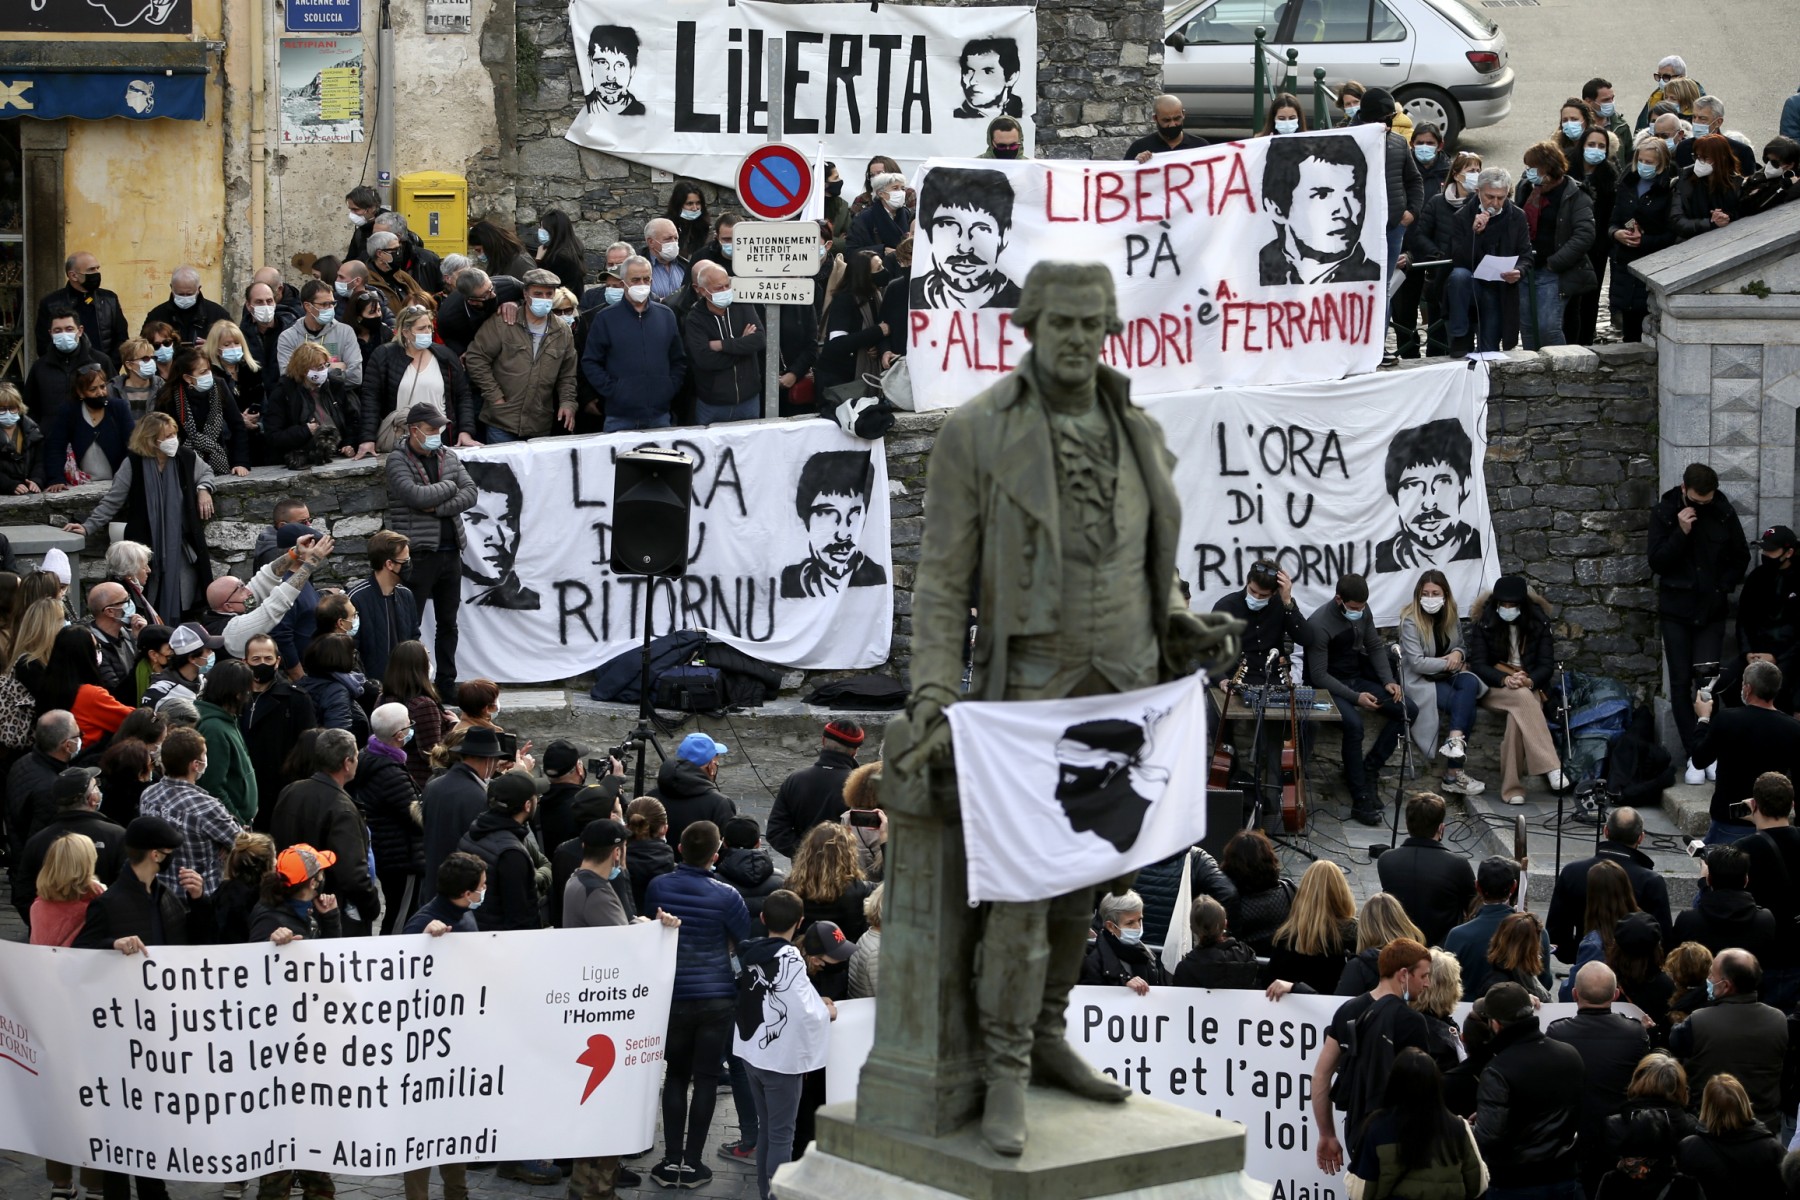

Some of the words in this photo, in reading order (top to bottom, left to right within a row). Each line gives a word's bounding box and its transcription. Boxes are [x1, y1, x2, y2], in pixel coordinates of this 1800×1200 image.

[304, 13, 343, 22] SCOLICCIA
[426, 15, 471, 26] POTERIE
[736, 236, 817, 245] STATIONNEMENT
[746, 254, 774, 262] PETIT
[779, 253, 808, 261] TRAIN
[738, 291, 805, 301] LIVRAISONS
[758, 281, 787, 290] SAUF
[1216, 421, 1350, 479] L'ORA
[1286, 491, 1314, 528] U
[142, 957, 249, 991] Contre
[264, 950, 434, 986] l'arbitraire
[582, 965, 620, 984] Ligue
[545, 989, 571, 1004] des
[578, 986, 627, 1003] droits
[632, 983, 649, 999] de
[92, 997, 125, 1029] et
[135, 998, 156, 1032] la
[169, 999, 278, 1042] justice
[292, 988, 465, 1032] d'exception
[563, 1008, 636, 1024] l'Homme
[1083, 1004, 1170, 1043] Pour
[1188, 1005, 1219, 1045] le
[129, 1038, 193, 1074] Pour
[208, 1041, 233, 1074] la
[249, 1032, 327, 1071] levée
[342, 1034, 393, 1067] des
[406, 1026, 452, 1063] DPS
[625, 1035, 661, 1051] Section
[624, 1054, 637, 1067] de
[640, 1049, 664, 1064] Corse
[1169, 1056, 1208, 1096] et
[79, 1076, 111, 1107] et
[121, 1077, 142, 1111] le
[154, 1075, 388, 1125] rapprochement
[400, 1064, 504, 1106] familial
[1264, 1110, 1308, 1152] loi
[89, 1137, 156, 1170] Pierre
[166, 1137, 296, 1175] Alessandri
[333, 1140, 396, 1168] Alain
[405, 1127, 498, 1163] Ferrandi
